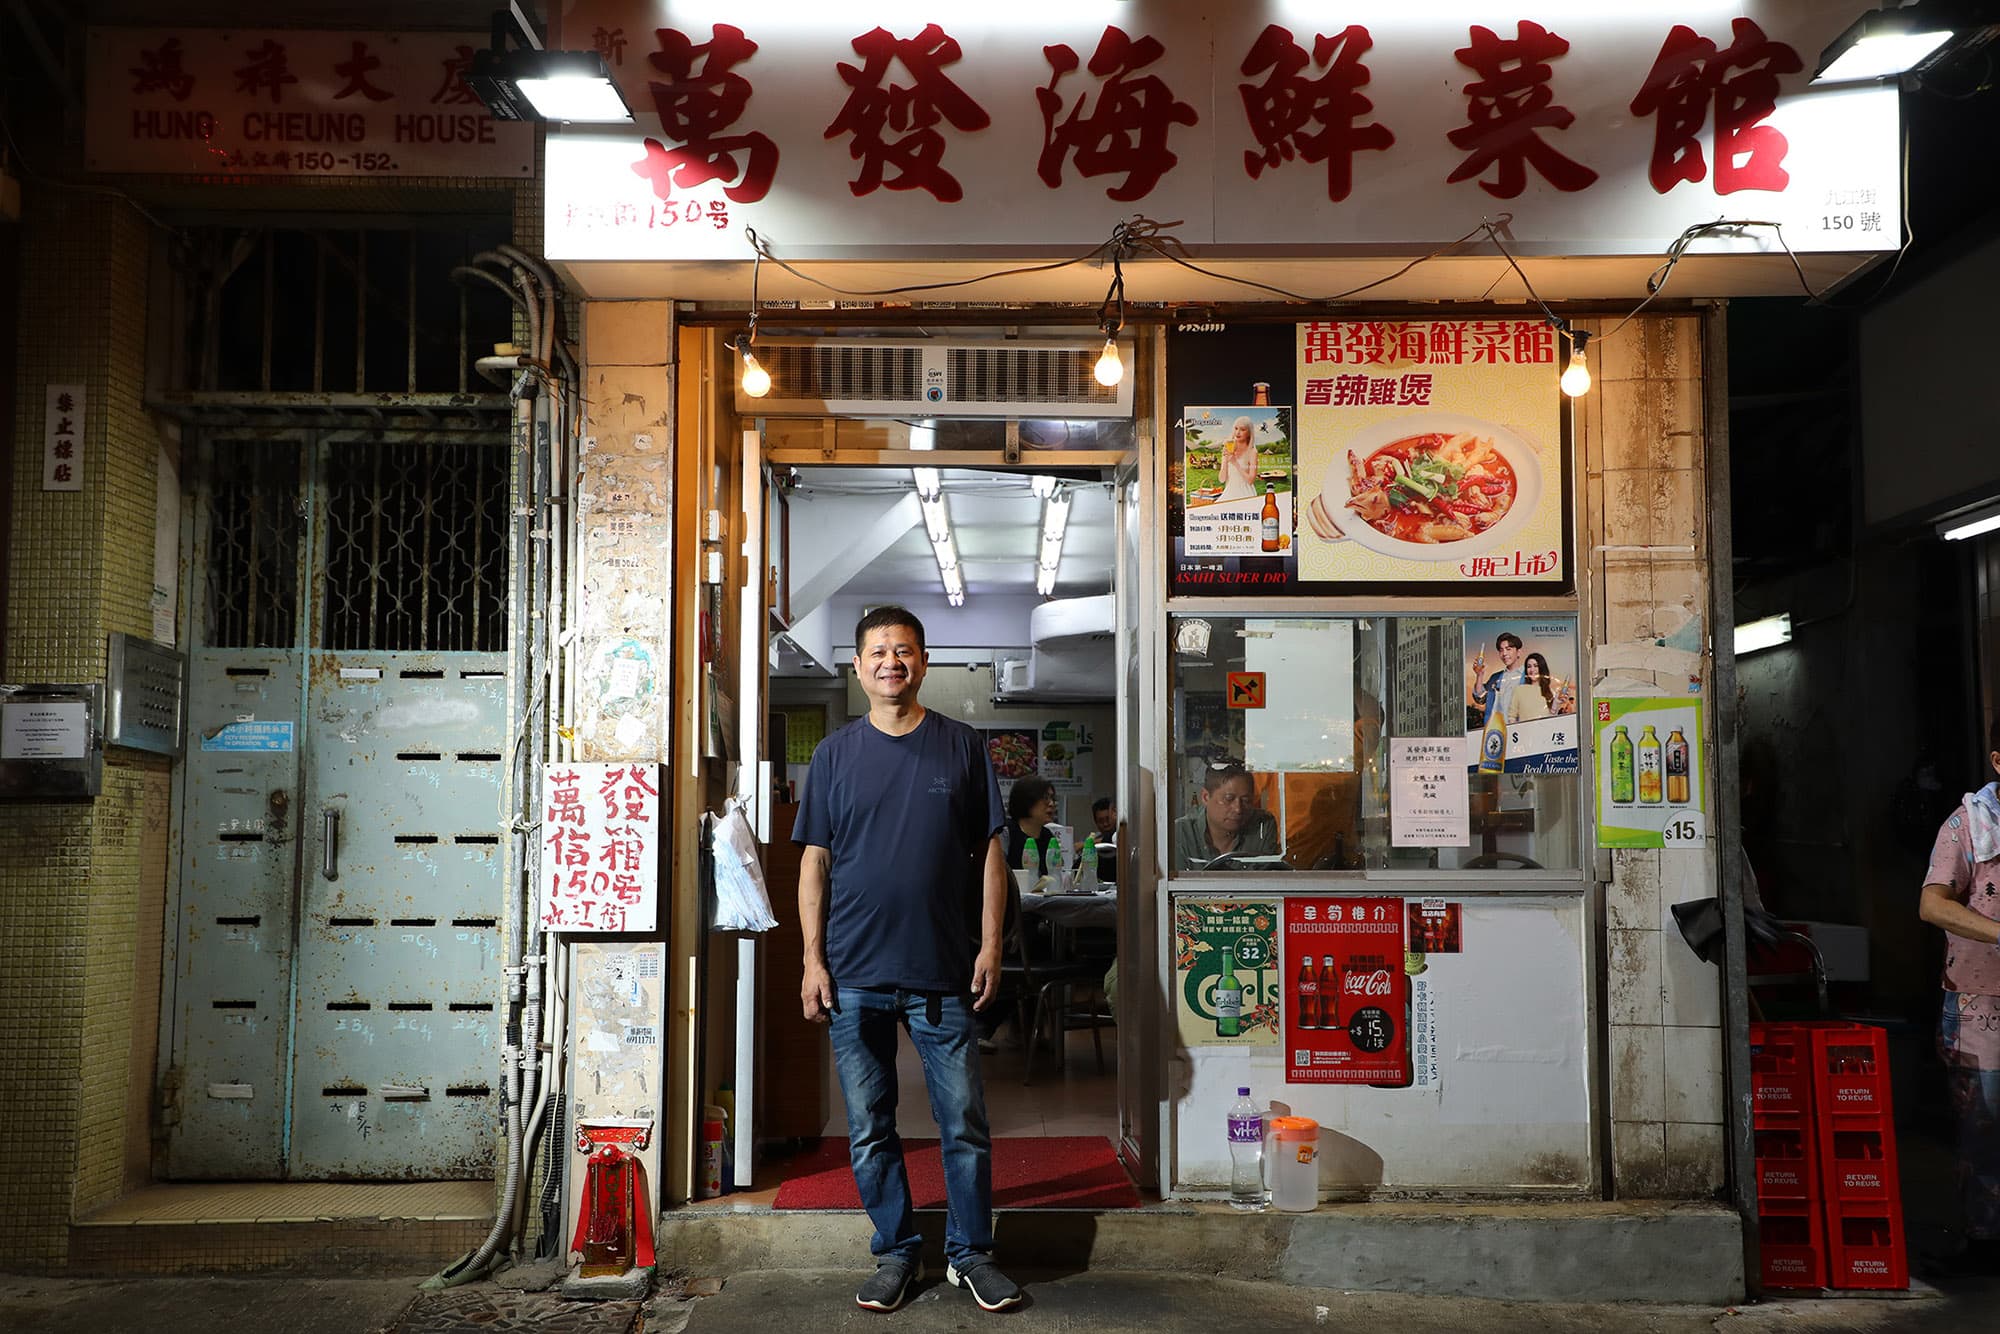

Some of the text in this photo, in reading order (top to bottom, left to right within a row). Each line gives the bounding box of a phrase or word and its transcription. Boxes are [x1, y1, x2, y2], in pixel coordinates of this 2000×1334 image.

[631, 17, 1804, 203] 萬發海鮮菜館
[133, 109, 496, 145] HUNG CHEUNG HOUSE
[1822, 211, 1883, 232] 150 號
[1303, 321, 1554, 366] 萬發海鮮菜館
[1303, 373, 1433, 407] 香辣雞煲
[1217, 572, 1260, 584] SUPER
[1262, 571, 1290, 583] DRY
[1468, 551, 1552, 578] 現已上市
[1531, 625, 1568, 633] BLUE GIRL
[1522, 763, 1578, 775] Real Moment
[1543, 752, 1578, 764] Taste the
[549, 764, 658, 827] 萬發
[1664, 821, 1696, 840] $15
[546, 824, 645, 872] 信箱
[552, 871, 642, 905] 150号
[1242, 947, 1260, 959] 32
[1344, 969, 1392, 996] Coca-Cola
[1234, 1121, 1261, 1137] vita
